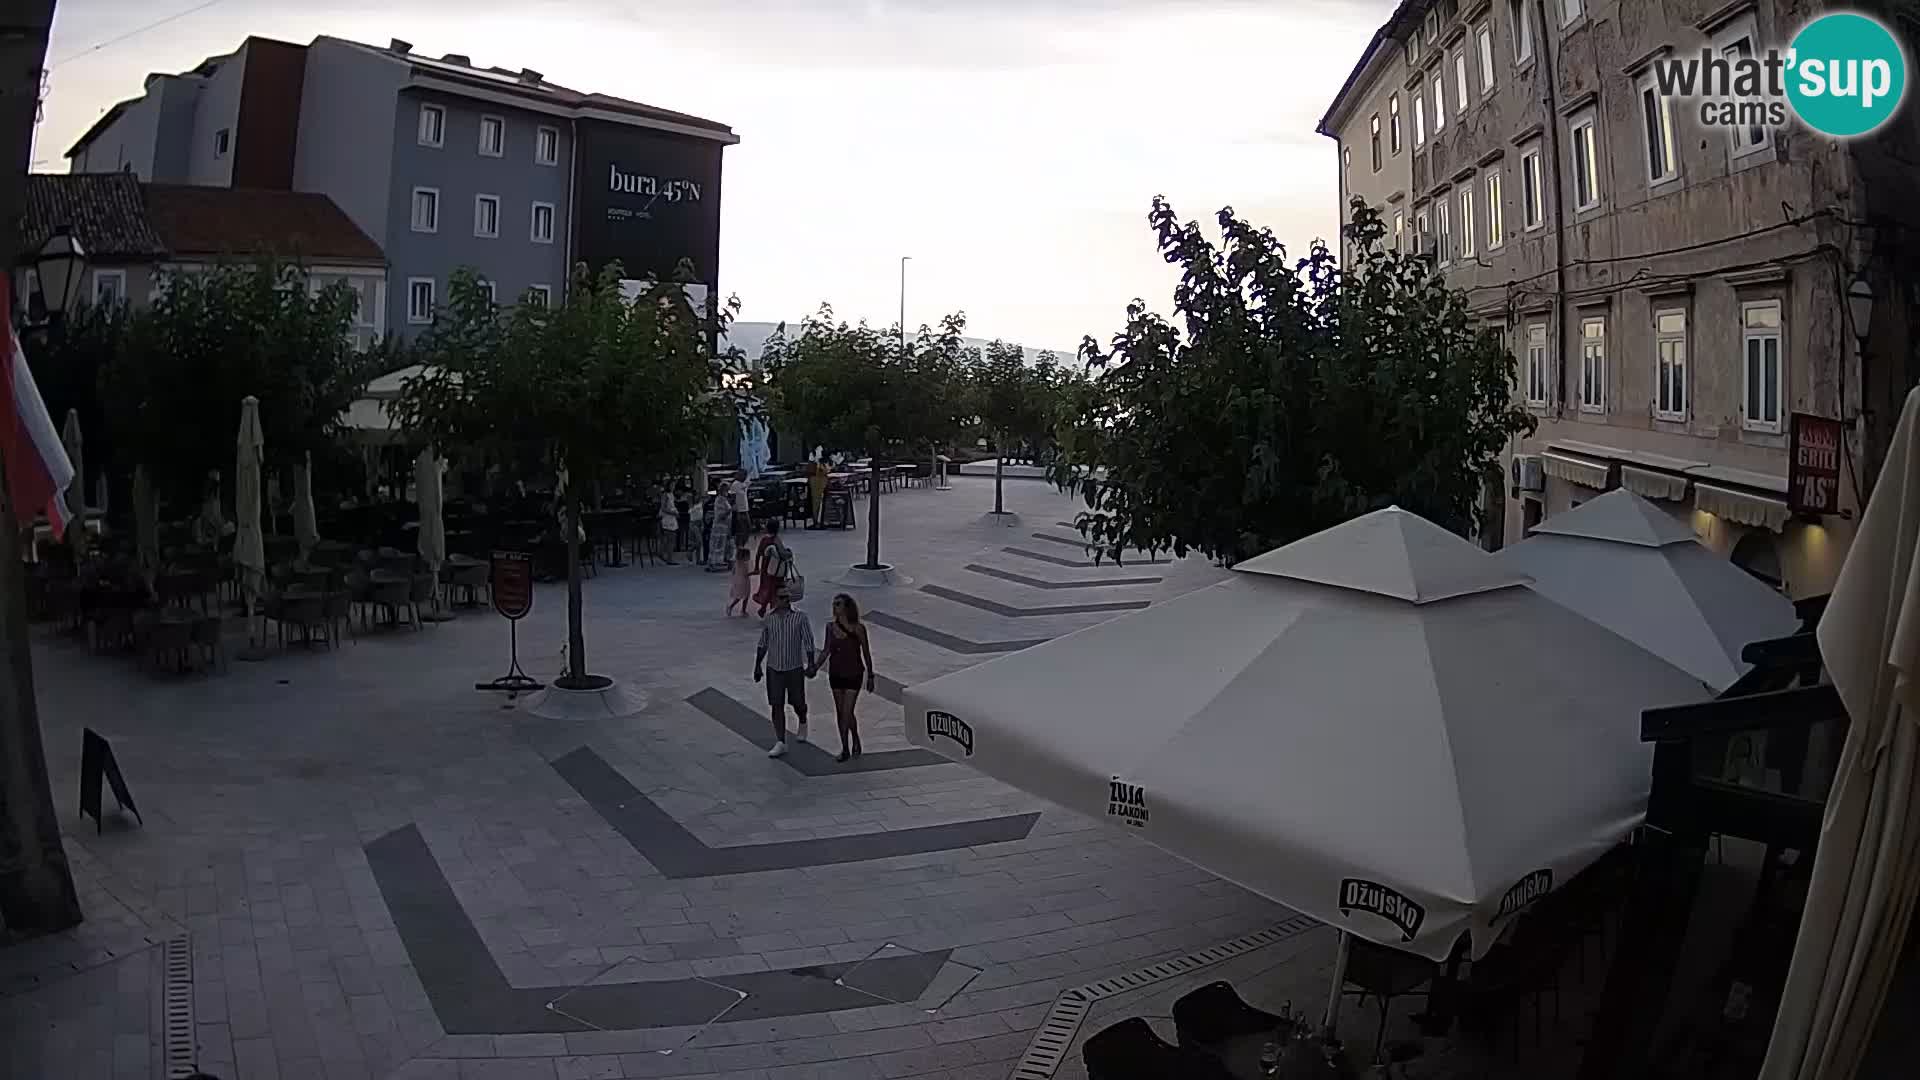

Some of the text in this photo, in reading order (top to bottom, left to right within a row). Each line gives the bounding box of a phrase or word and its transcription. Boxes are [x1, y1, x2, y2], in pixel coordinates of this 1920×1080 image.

[610, 164, 656, 195] bura
[1798, 447, 1837, 470] GRILL
[1110, 775, 1145, 807] ŽUJA
[1346, 882, 1418, 929] Ožujsko
